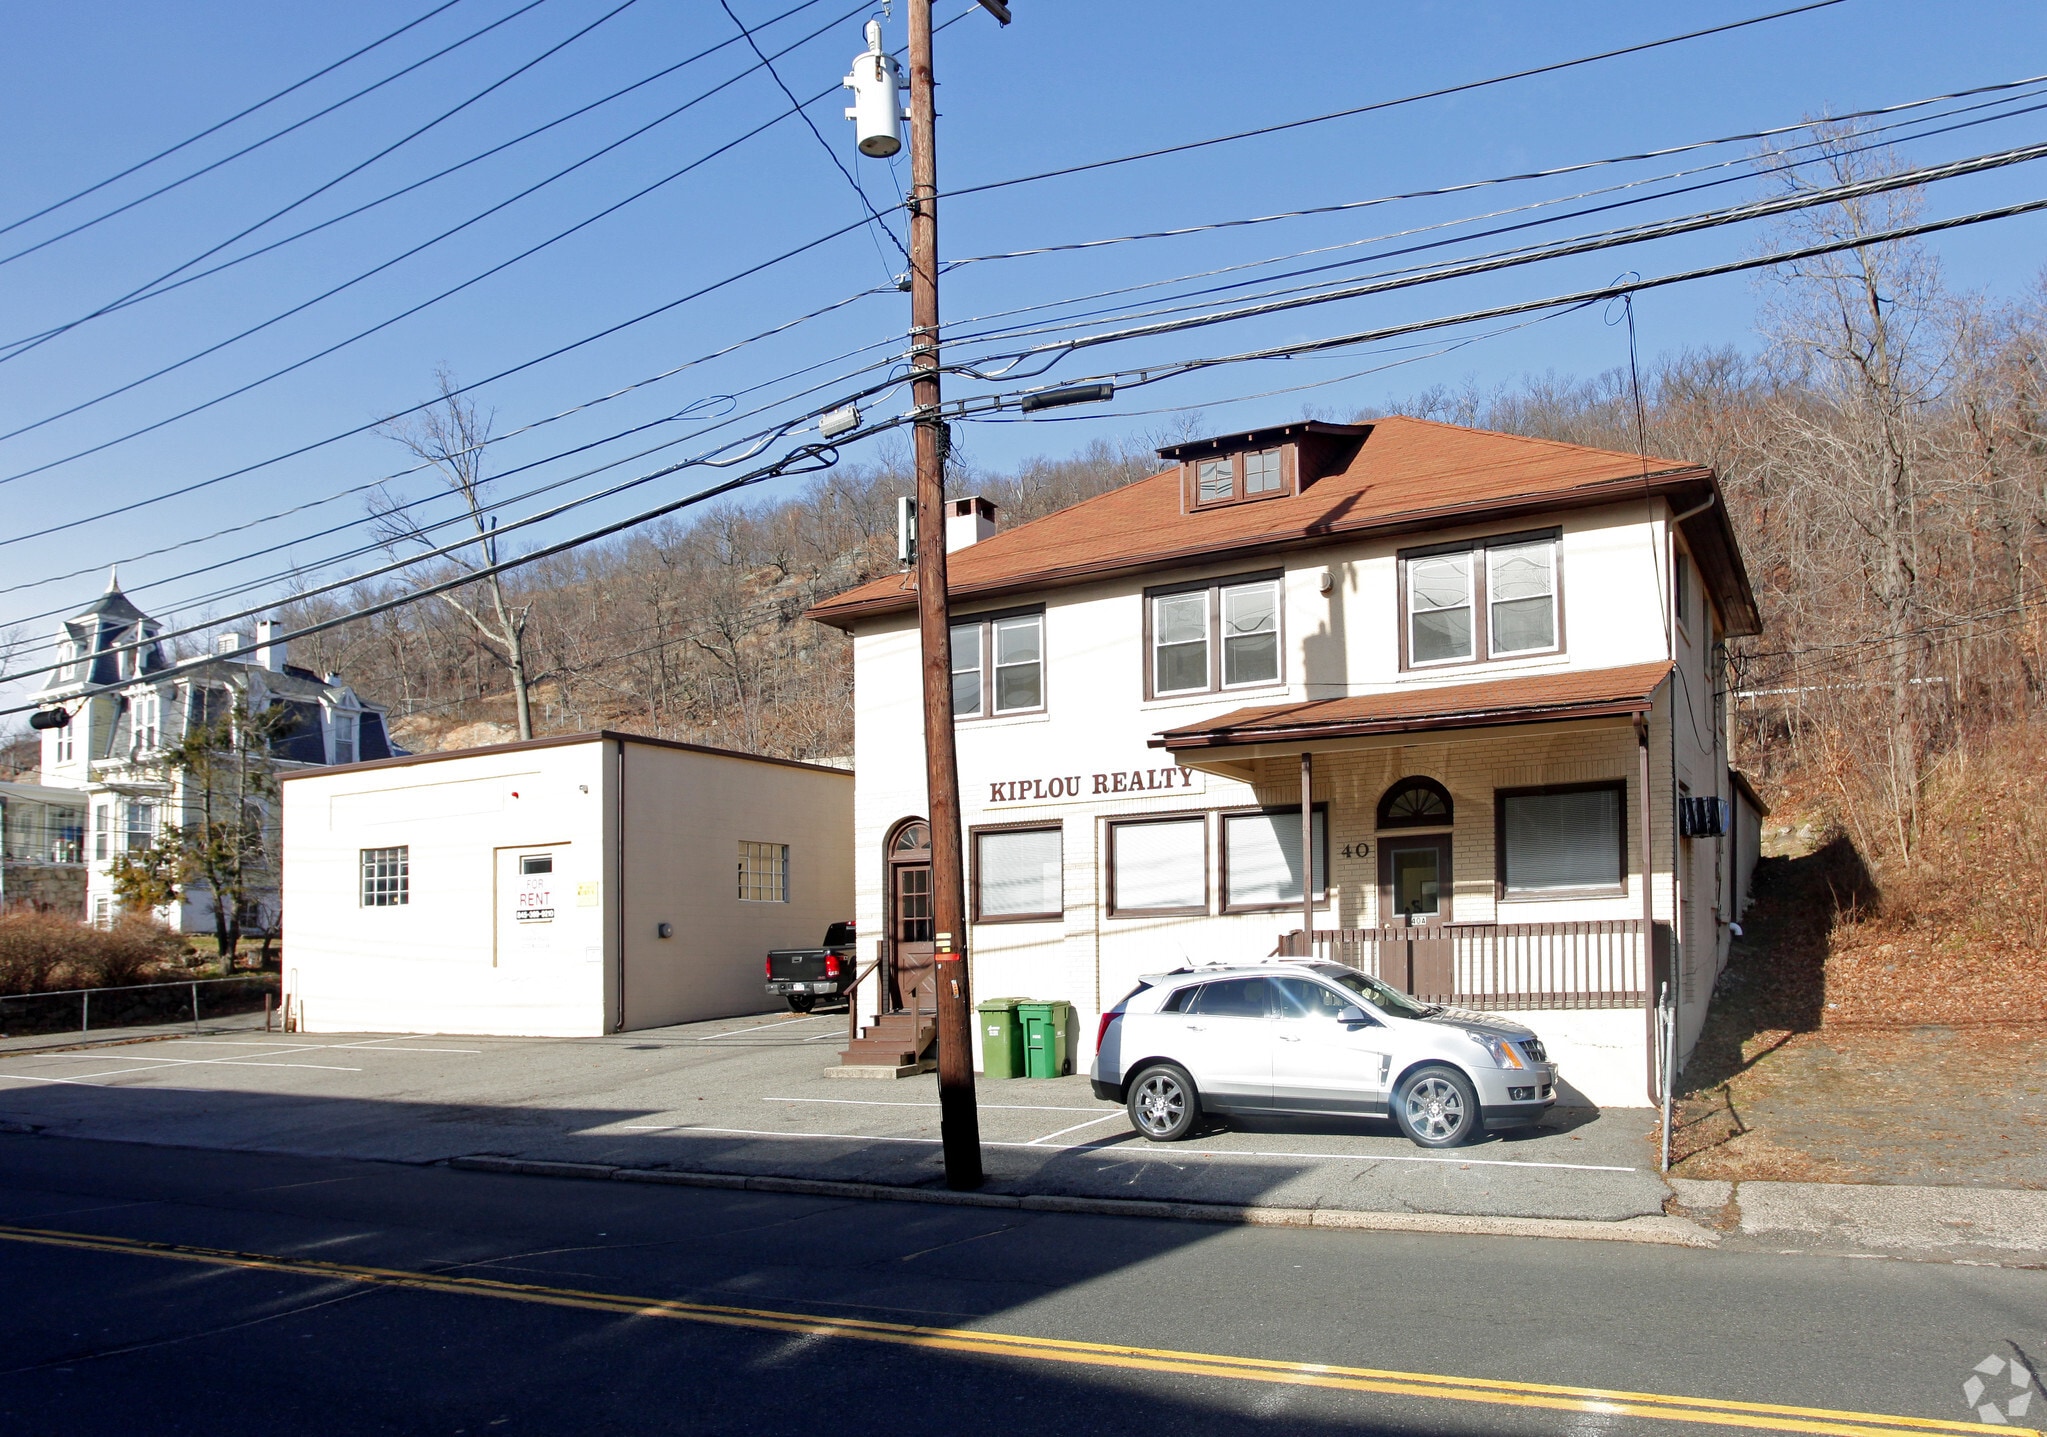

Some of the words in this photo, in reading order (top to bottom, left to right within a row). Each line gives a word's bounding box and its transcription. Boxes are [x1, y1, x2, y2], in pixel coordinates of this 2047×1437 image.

[989, 776, 1081, 802] KIPLOU
[1092, 766, 1193, 794] REALTY
[1341, 843, 1369, 858] 40
[526, 878, 544, 889] FOR
[520, 891, 550, 906] RENT
